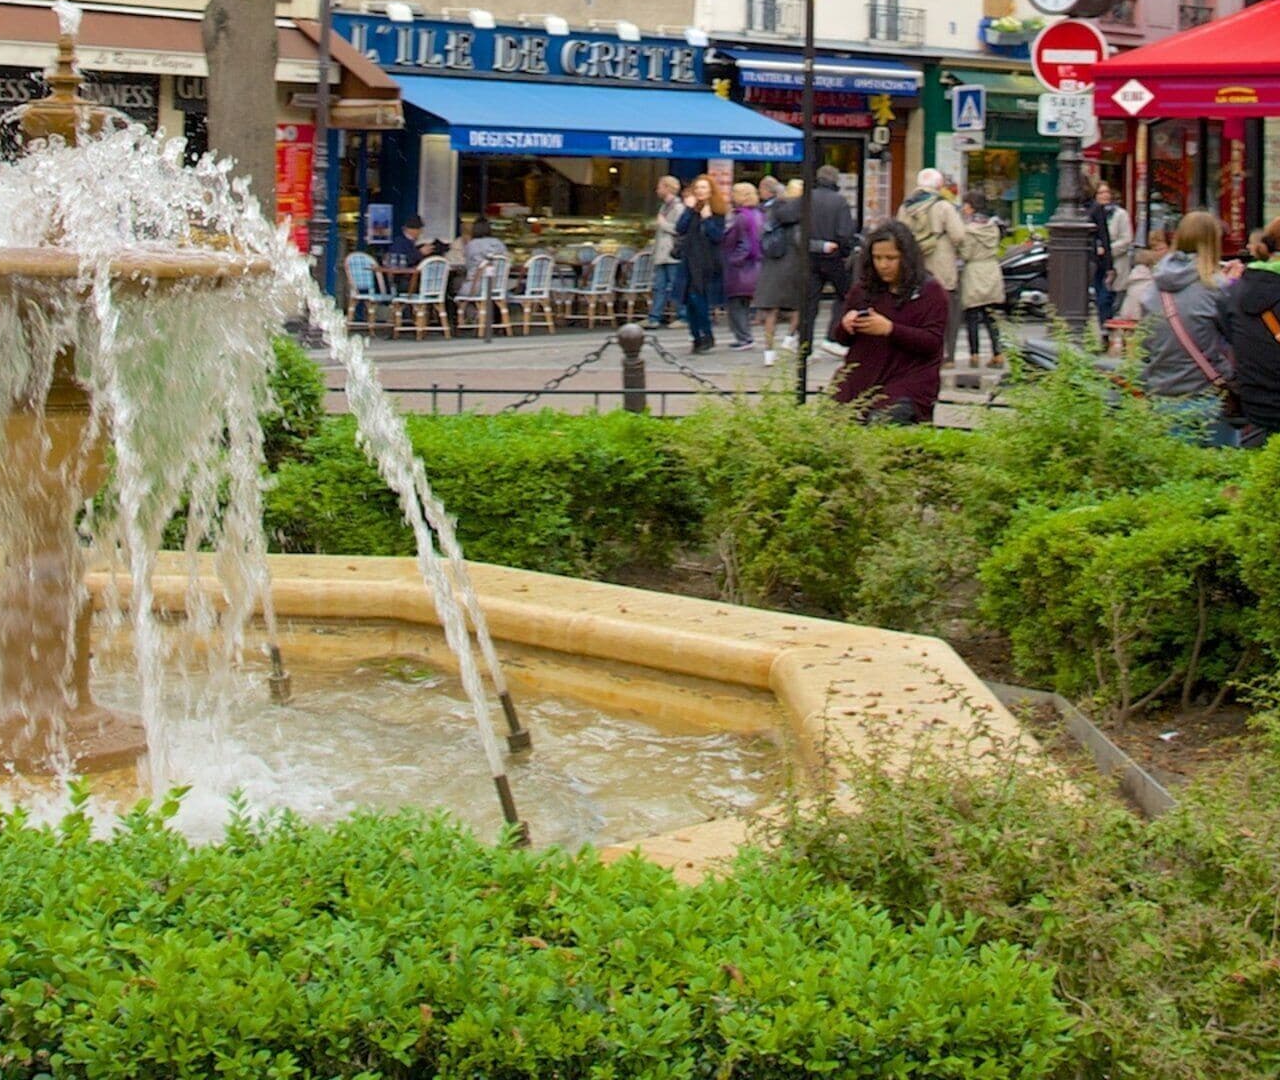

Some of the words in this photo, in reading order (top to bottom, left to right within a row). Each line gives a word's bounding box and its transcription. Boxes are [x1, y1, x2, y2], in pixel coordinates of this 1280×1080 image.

[493, 33, 549, 74] DE
[561, 40, 697, 84] CRETE
[609, 136, 673, 153] TRAITEUR
[720, 140, 794, 156] RESTAURANT
